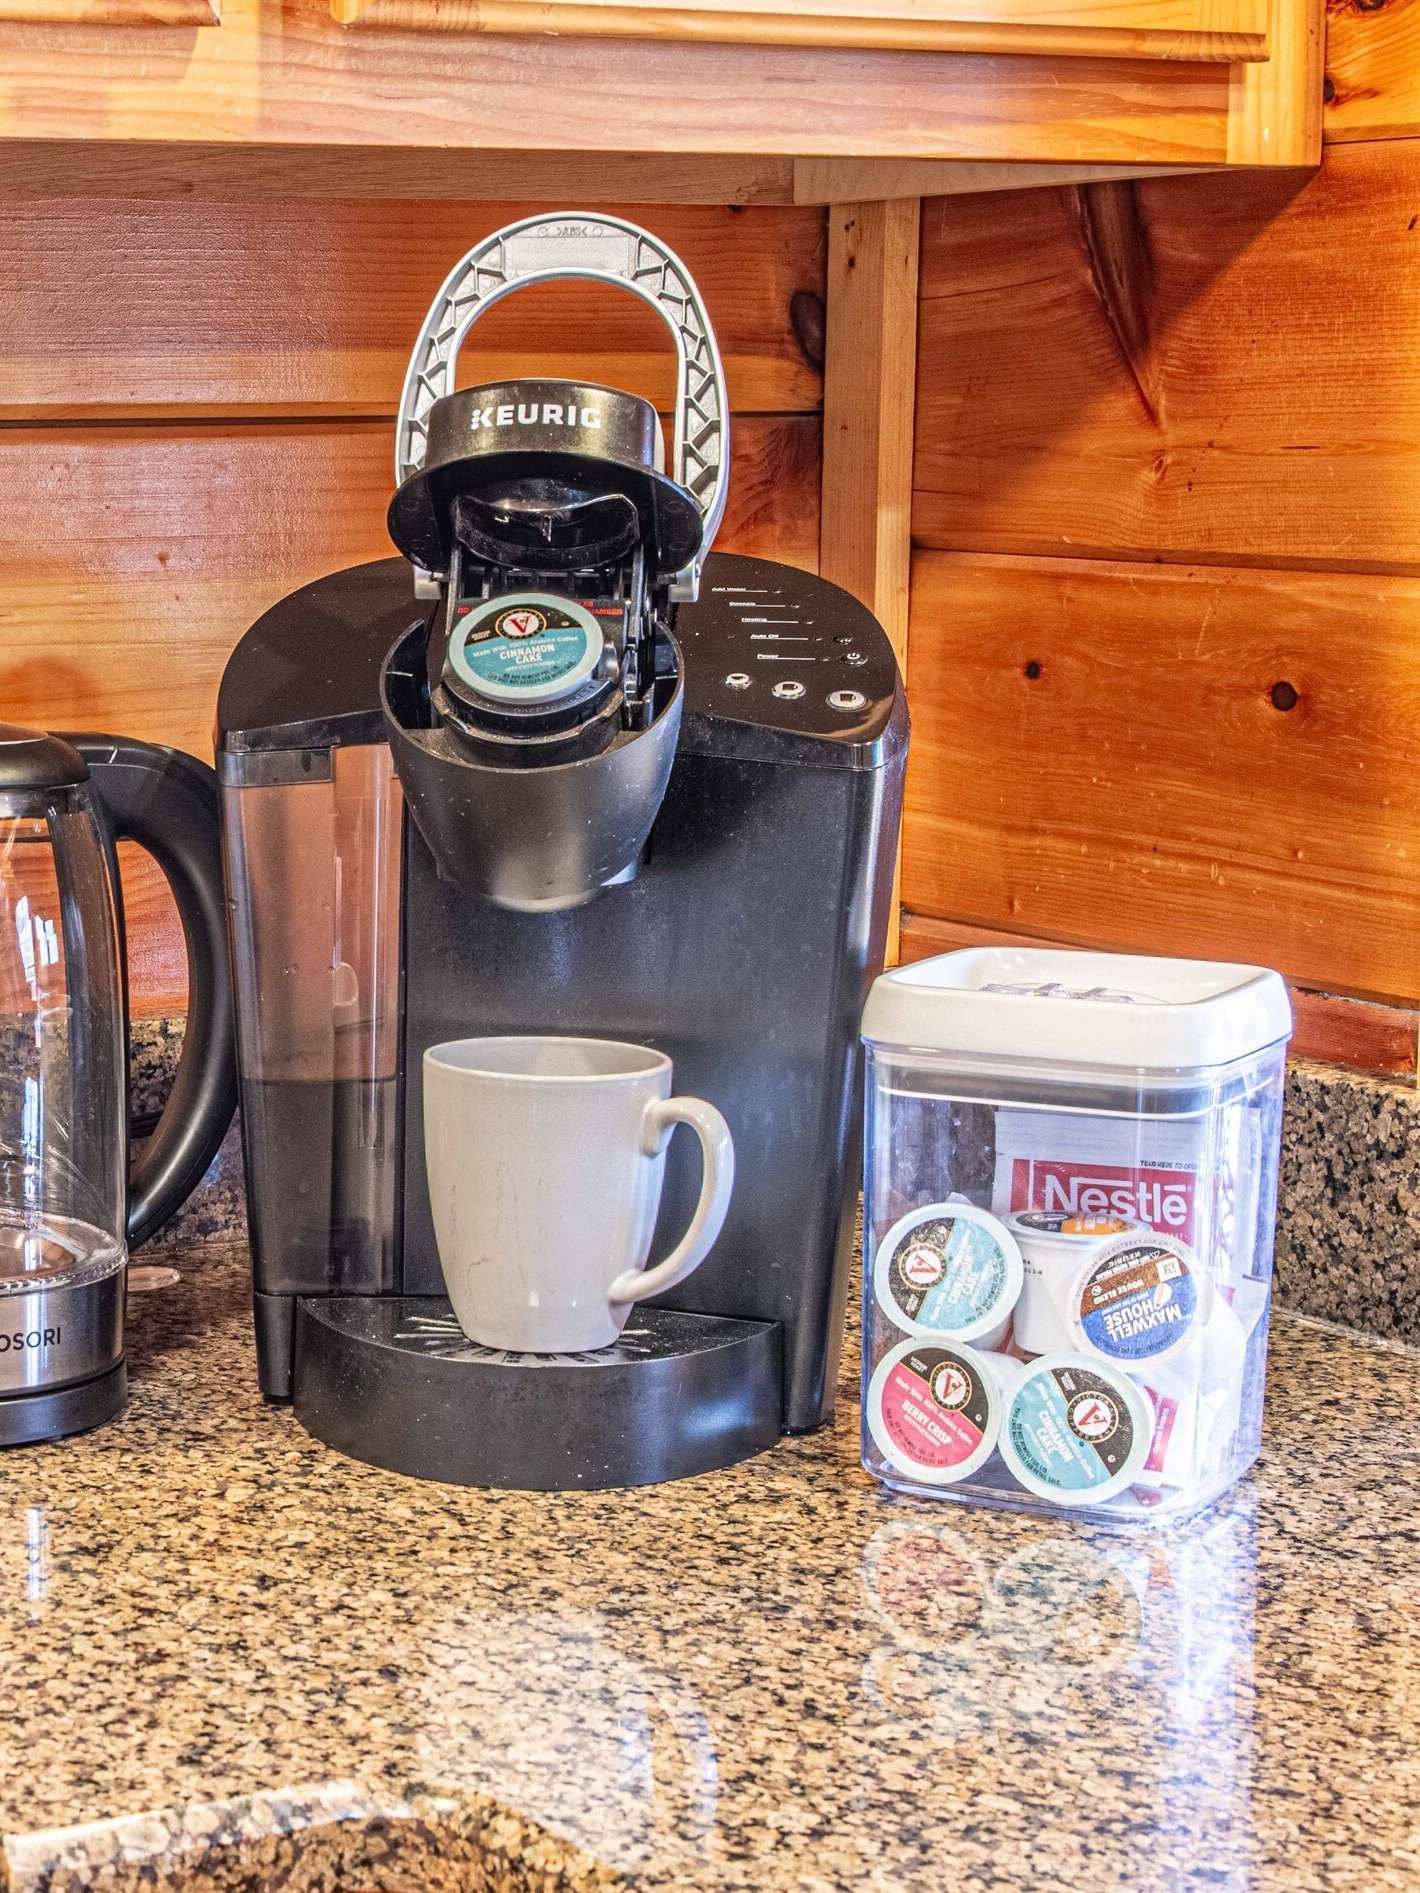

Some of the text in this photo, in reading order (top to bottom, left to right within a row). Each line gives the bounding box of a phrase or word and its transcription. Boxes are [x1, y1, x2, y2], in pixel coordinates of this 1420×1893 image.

[470, 403, 602, 430] KEURIG
[499, 643, 555, 660] CINNAMON
[515, 654, 543, 665] CAKE
[1093, 1278, 1144, 1305] HOUSE BLEND
[1103, 1299, 1153, 1329] HOUSE
[1107, 1303, 1183, 1342] MAXWELL
[895, 1376, 910, 1391] Made
[901, 1400, 930, 1426] BERRY
[927, 1419, 953, 1445] CRISP
[1036, 1428, 1057, 1455] CAKE
[1038, 1410, 1074, 1463] CINNAMON
